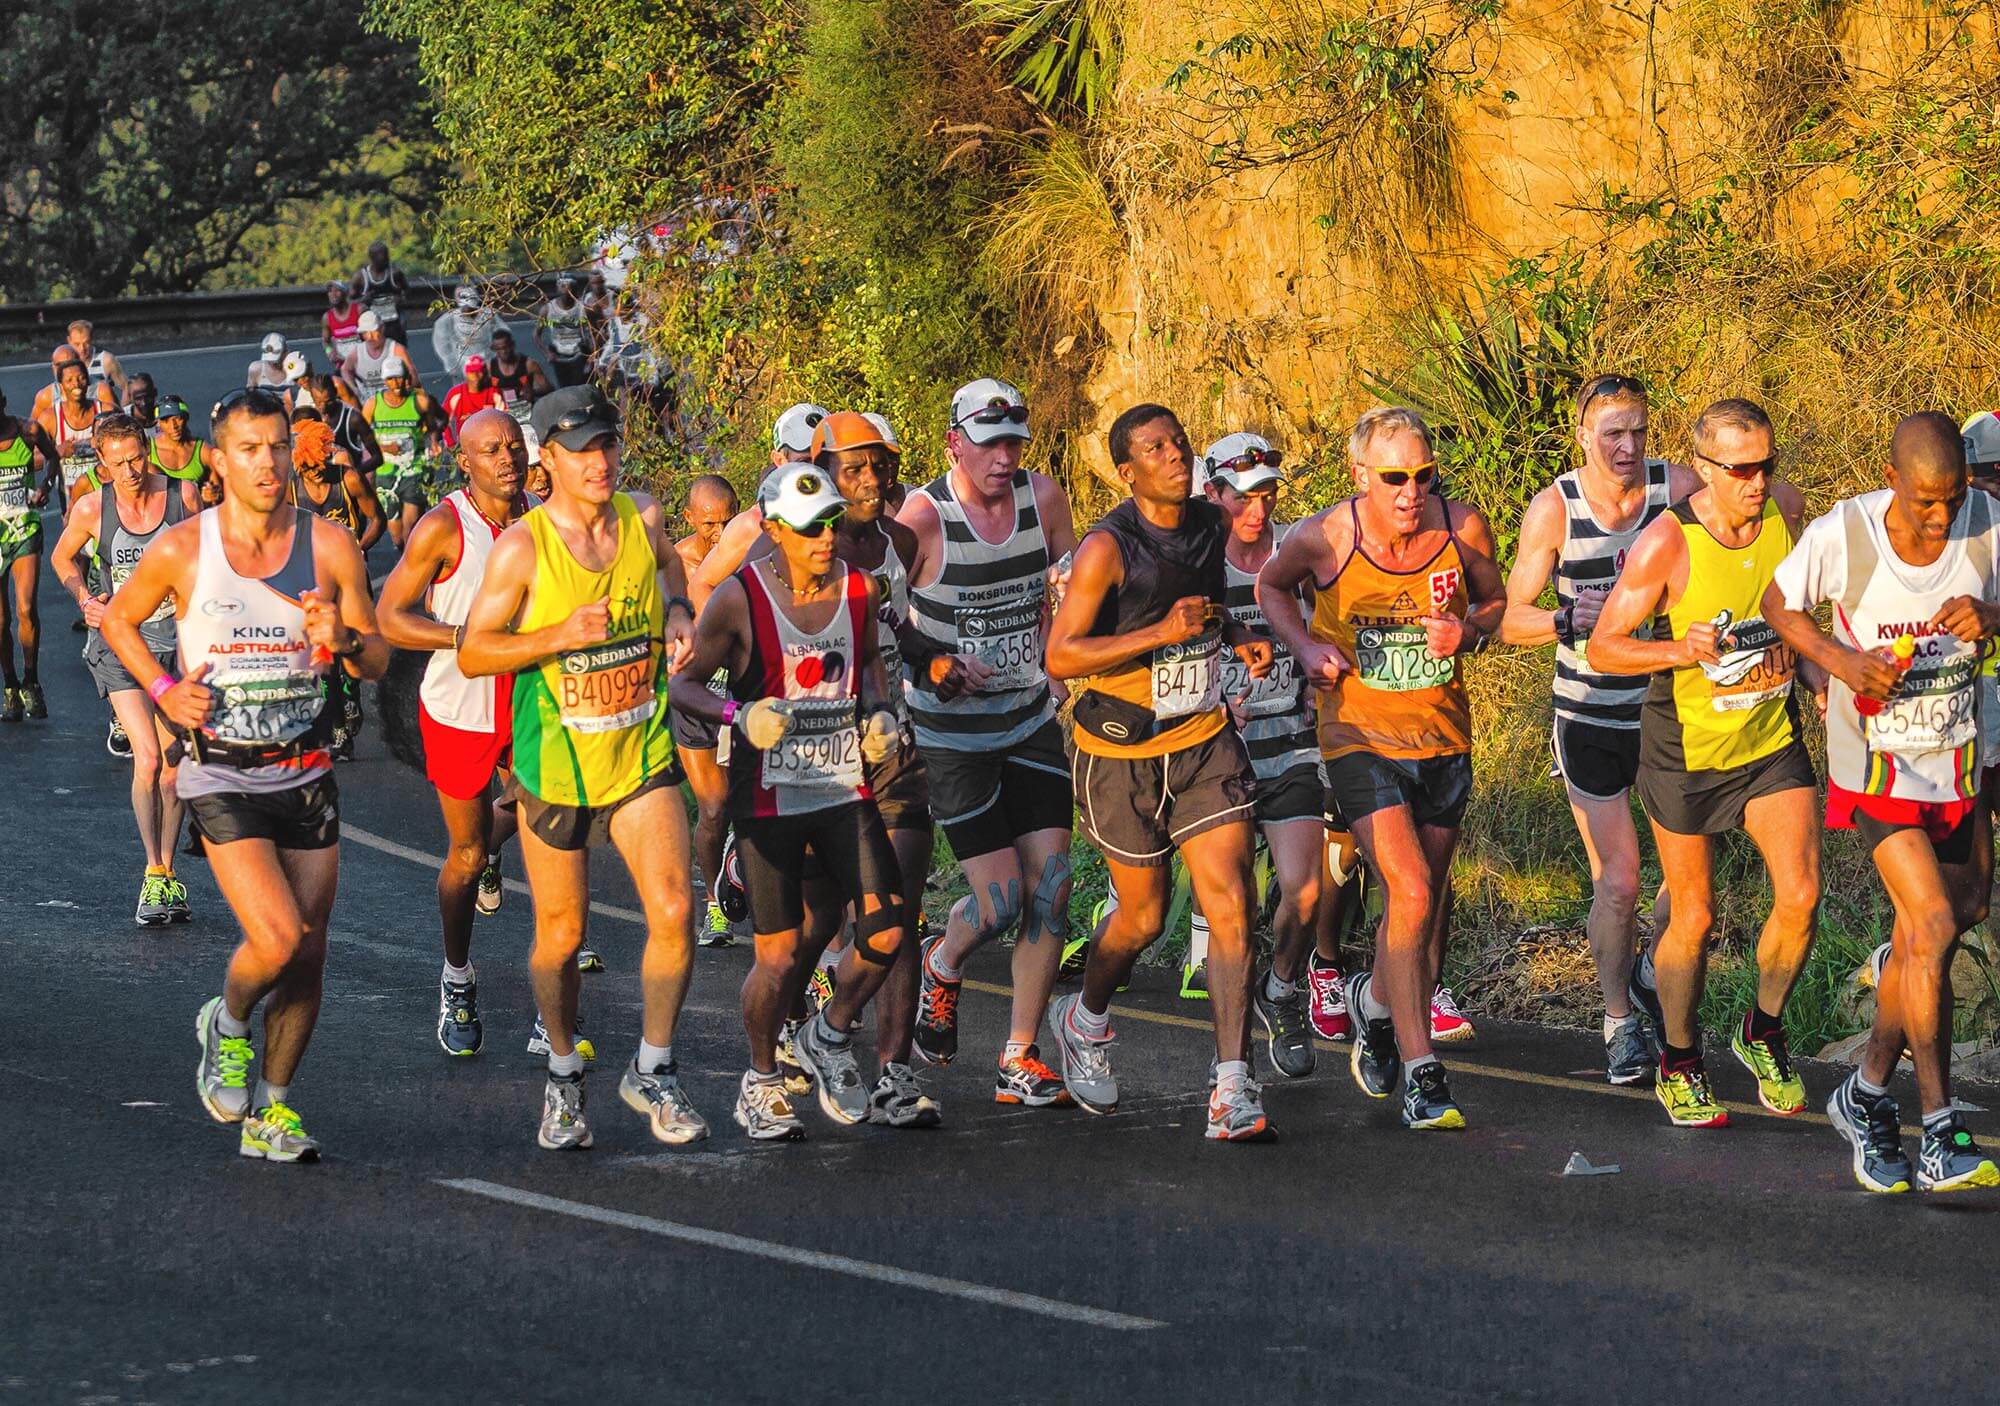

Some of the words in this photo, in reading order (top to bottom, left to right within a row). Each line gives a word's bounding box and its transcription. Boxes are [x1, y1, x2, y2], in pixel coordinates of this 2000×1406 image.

[116, 548, 144, 564] SEC
[958, 584, 1024, 602] BOKSBURG
[1433, 572, 1457, 603] 55
[988, 611, 1037, 631] NEDBANK
[233, 627, 286, 638] KING
[1385, 632, 1428, 644] NEDBA
[208, 641, 306, 655] AUSTRALIA
[591, 643, 649, 666] NEDBANK
[792, 639, 832, 658] LENASIA
[834, 636, 847, 648] AC
[996, 666, 1023, 678] WAYNE
[1904, 671, 1969, 692] NEDBANK
[1875, 690, 1971, 735] C54682
[768, 730, 856, 771] B39902
